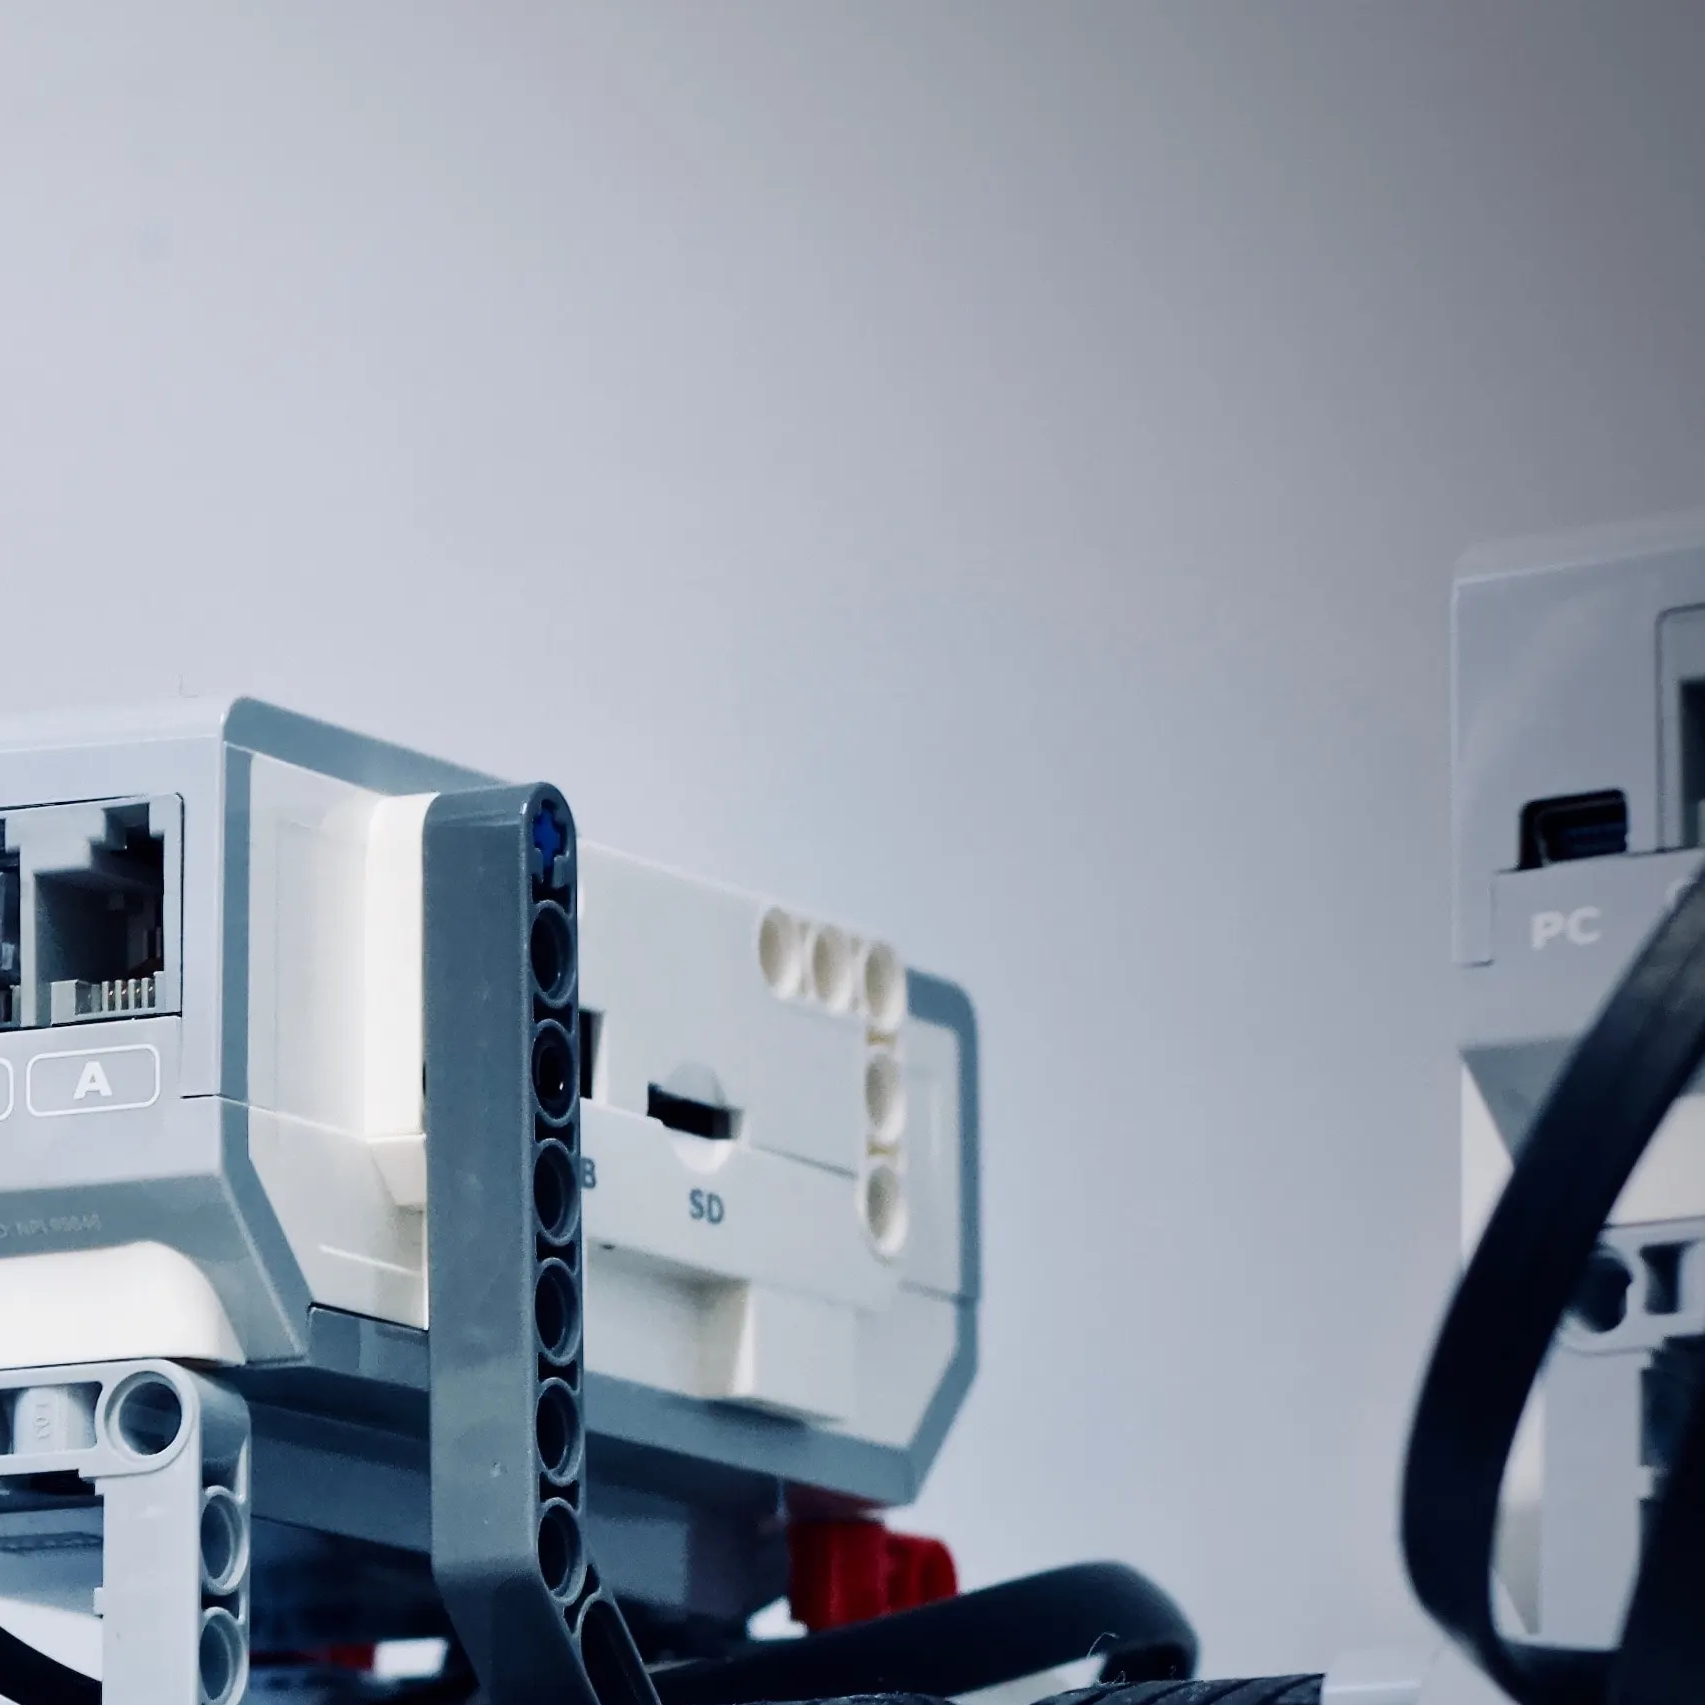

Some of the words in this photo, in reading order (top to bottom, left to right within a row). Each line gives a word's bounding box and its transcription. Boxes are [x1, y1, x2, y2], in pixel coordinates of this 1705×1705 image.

[1532, 905, 1600, 949] PC
[74, 1062, 113, 1099] A
[689, 1188, 724, 1224] SD
